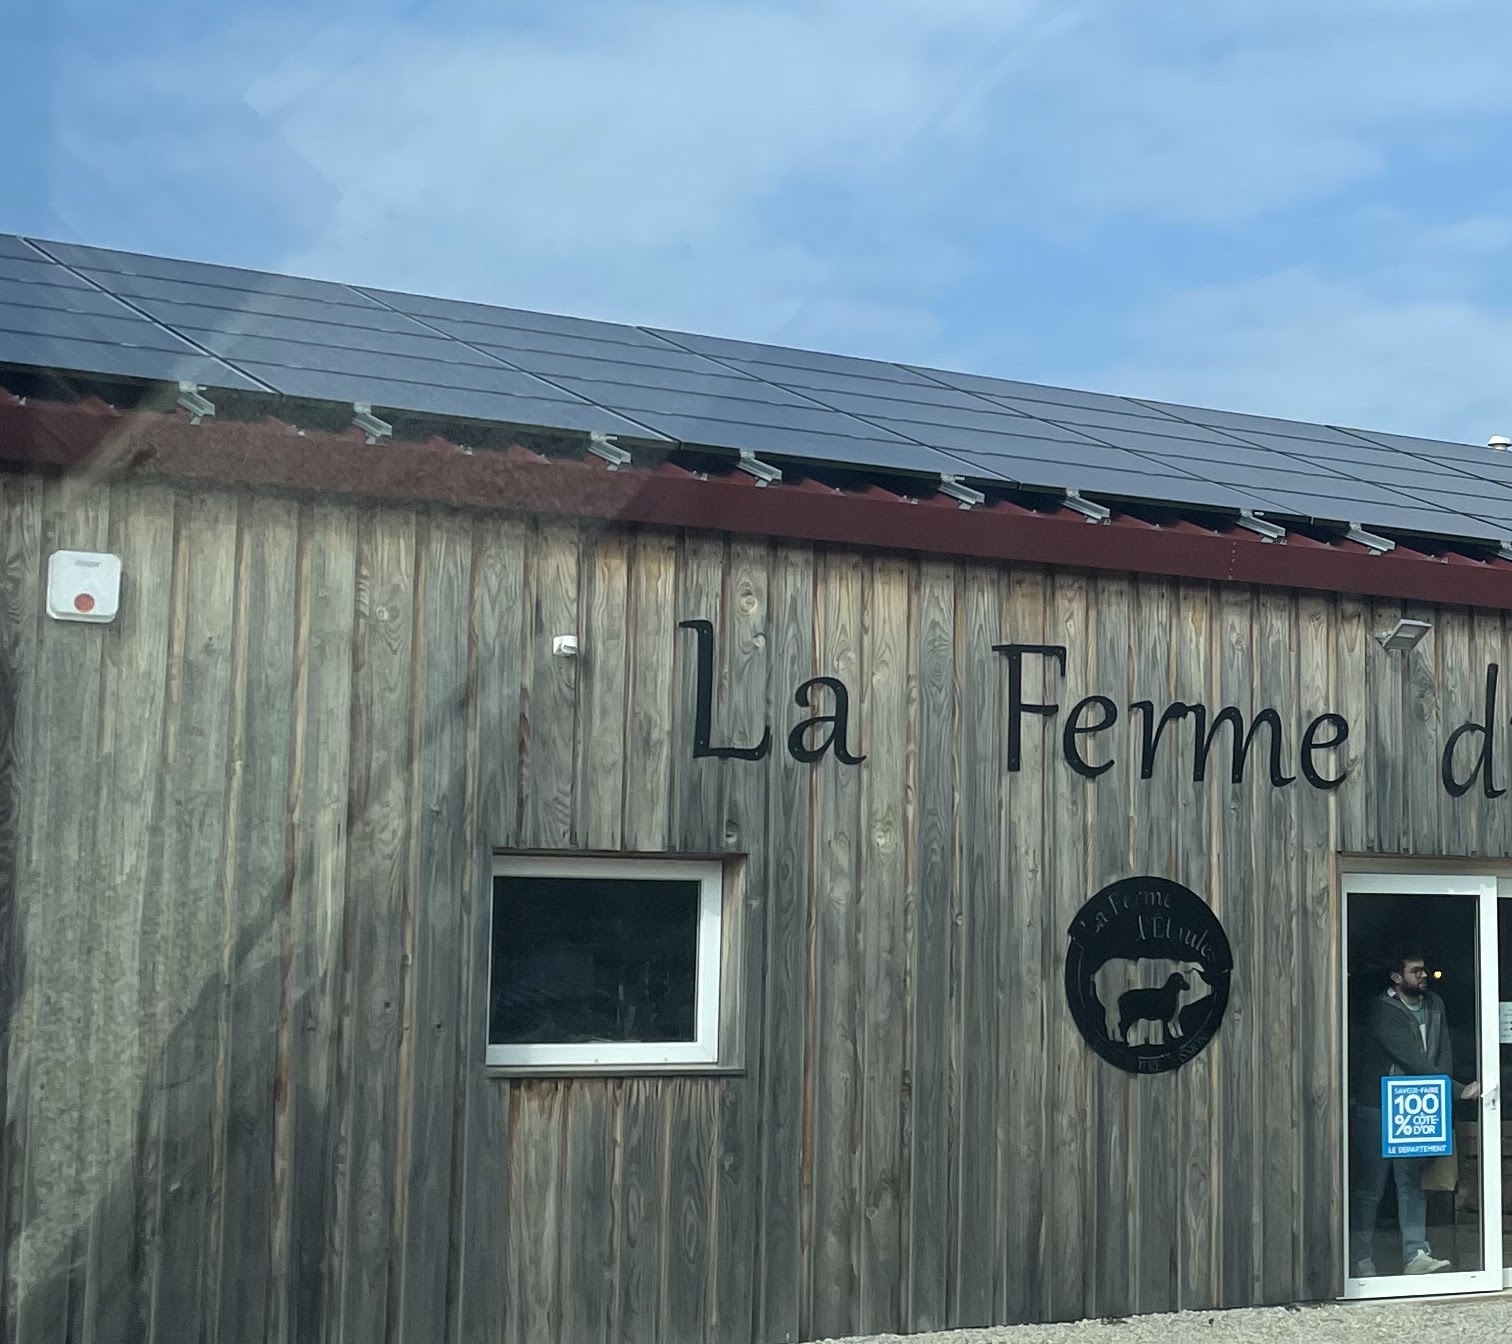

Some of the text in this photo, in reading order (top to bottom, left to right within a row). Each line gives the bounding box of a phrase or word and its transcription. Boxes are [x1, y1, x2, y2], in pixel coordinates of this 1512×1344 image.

[679, 619, 867, 765] La
[991, 644, 1349, 789] Ferme
[1394, 1093, 1440, 1115] 100
[1394, 1115, 1412, 1136] %
[1413, 1125, 1436, 1135] D'OR
